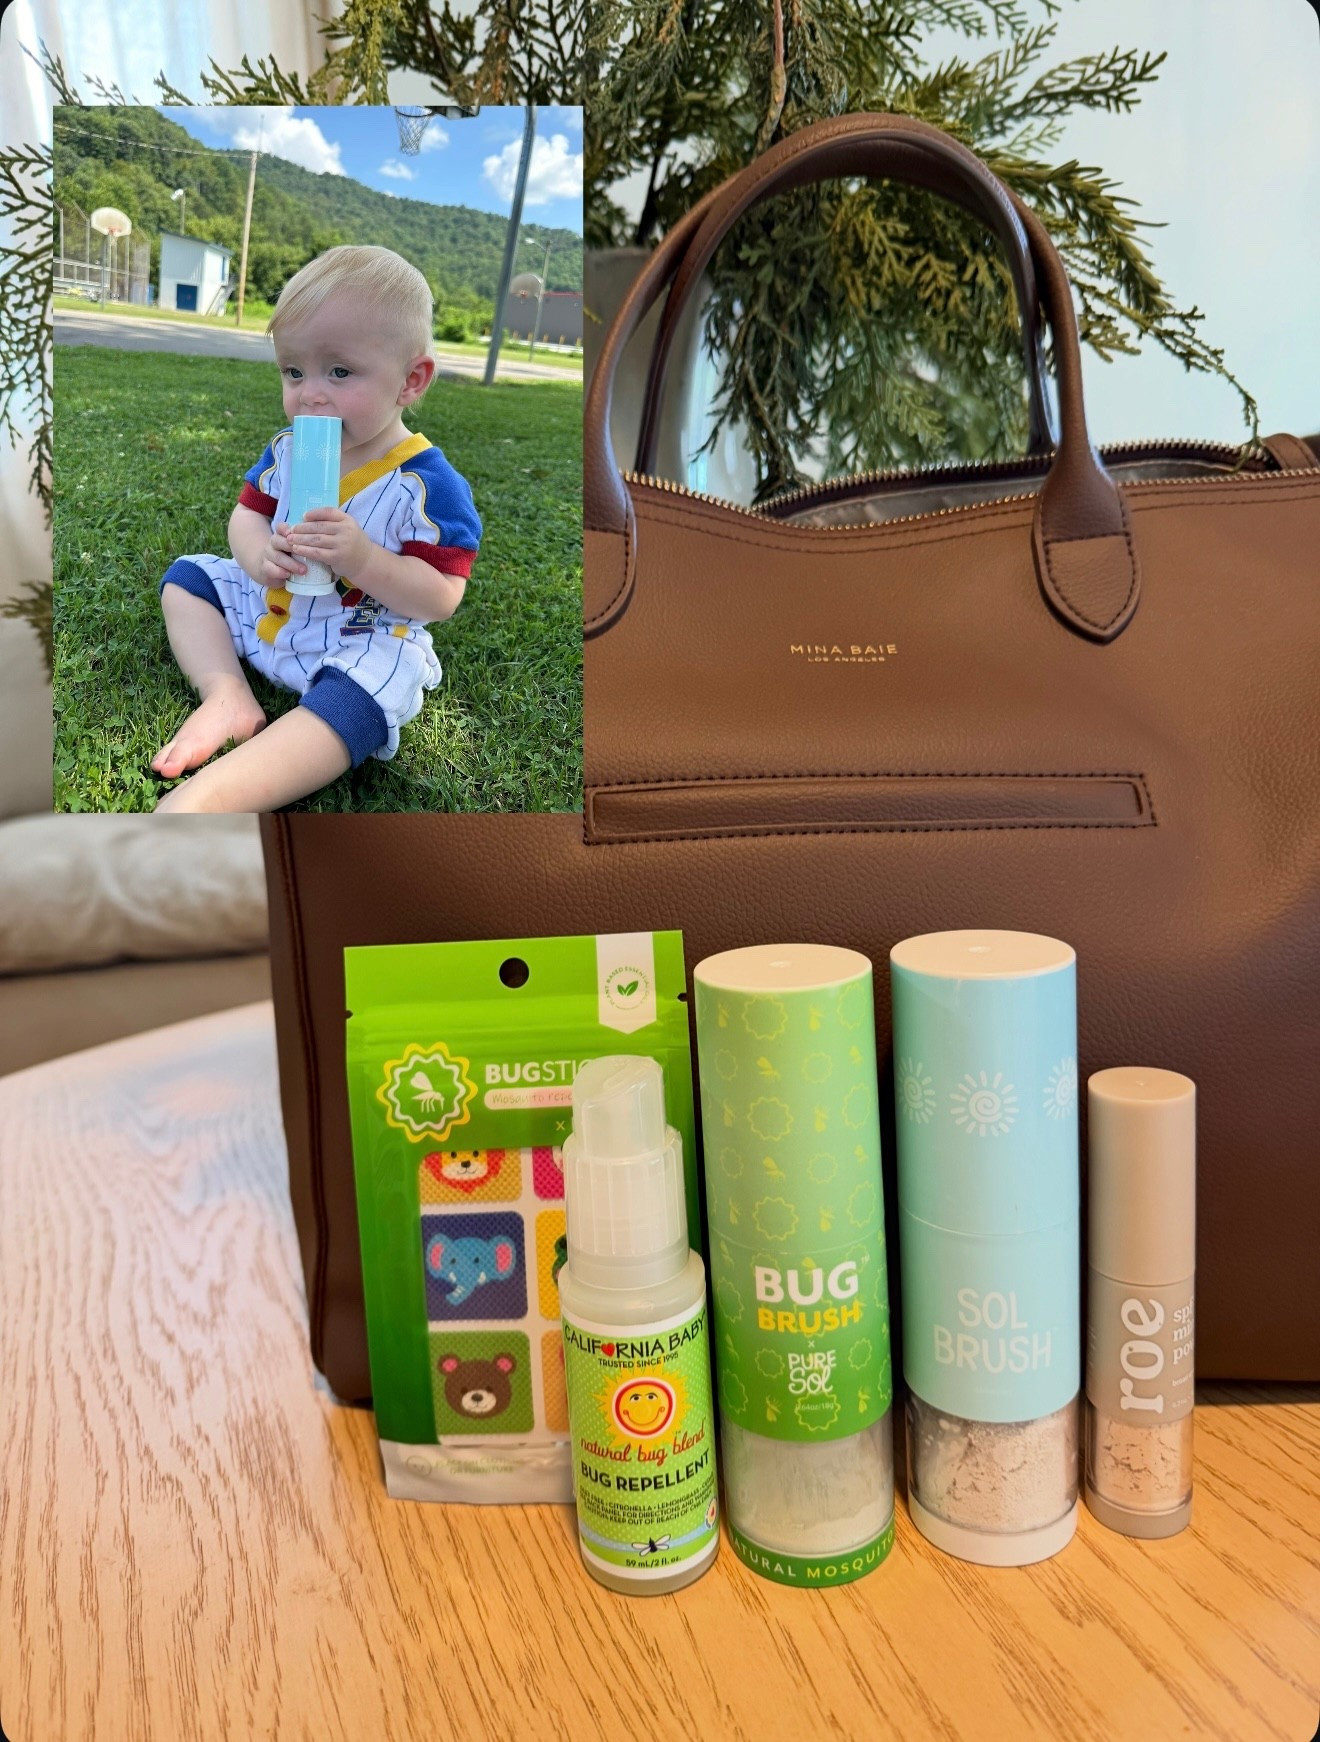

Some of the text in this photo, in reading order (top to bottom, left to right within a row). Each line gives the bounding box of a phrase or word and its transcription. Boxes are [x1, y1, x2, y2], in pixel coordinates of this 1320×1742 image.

[790, 644, 898, 655] MINA BAIE
[755, 1260, 859, 1305] BUG
[757, 1301, 862, 1334] BRUSH
[956, 1287, 1028, 1330] SOL
[668, 1313, 705, 1351] BABY
[598, 1352, 680, 1369] TRUSTED SINCE 1995
[787, 1349, 837, 1370] PURE
[933, 1323, 1052, 1375] BRUSH
[1119, 1298, 1166, 1414] roe
[788, 1365, 834, 1395] Sol
[580, 1423, 705, 1467] natural bug blend
[580, 1461, 611, 1488] BUG
[616, 1448, 709, 1492] REPELLENT
[608, 1502, 652, 1512] CITRONELLA
[657, 1489, 700, 1511] LEMONGRASS
[622, 1511, 637, 1519] FOR
[638, 1504, 680, 1518] DIRECTIONS
[681, 1500, 694, 1510] AND
[627, 1518, 643, 1526] OUT
[644, 1517, 655, 1525] OF
[656, 1512, 680, 1524] REACH
[680, 1508, 689, 1517] OF
[625, 1558, 638, 1568] 59
[729, 1527, 894, 1578] NATURAL MOSQUITO
